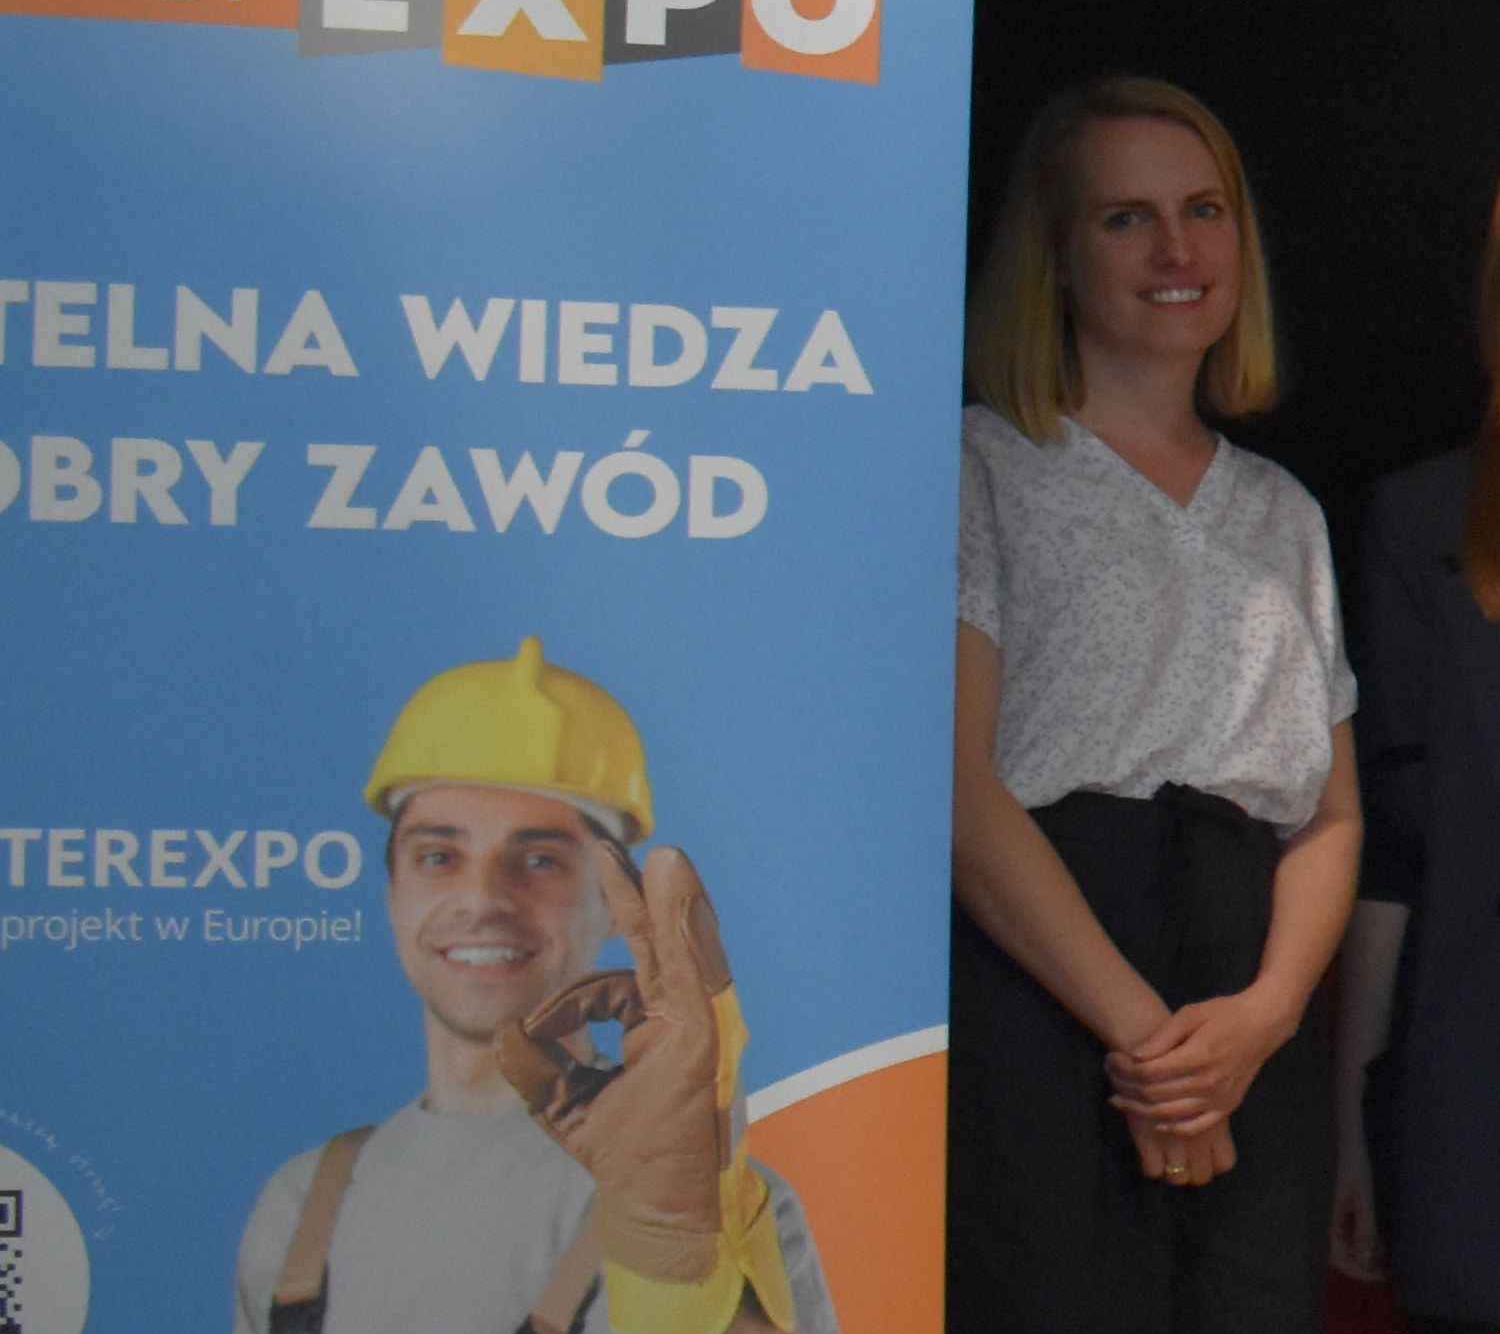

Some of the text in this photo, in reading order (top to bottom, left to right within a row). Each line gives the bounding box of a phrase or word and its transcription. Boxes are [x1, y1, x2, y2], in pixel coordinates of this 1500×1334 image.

[400, 292, 876, 396] WIEDZA
[0, 429, 770, 541] BRY ZAWÓD
[0, 827, 364, 890] TEREXPO
[1, 907, 363, 952] projekt w Europie!
